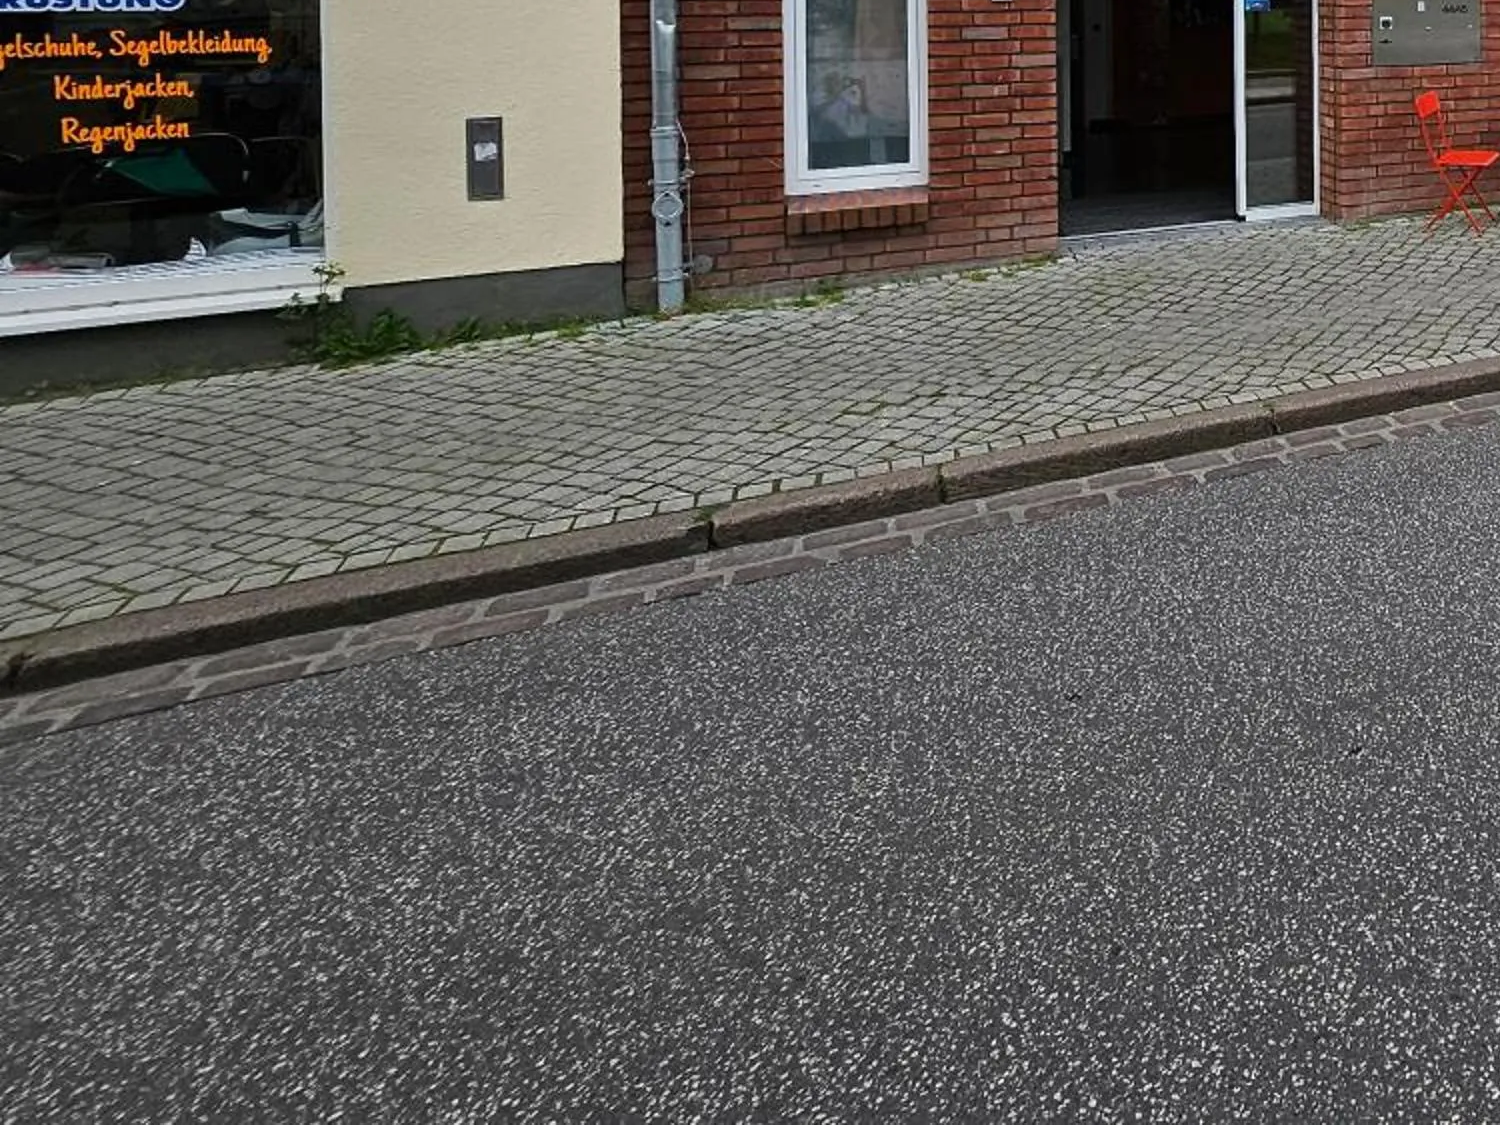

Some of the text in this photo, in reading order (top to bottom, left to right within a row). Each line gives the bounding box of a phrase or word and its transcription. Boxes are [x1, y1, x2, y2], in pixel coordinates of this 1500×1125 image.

[109, 30, 273, 67] Segelbekleidung,
[54, 71, 195, 110] Kinderjacken,
[61, 115, 190, 154] Regenjacken
